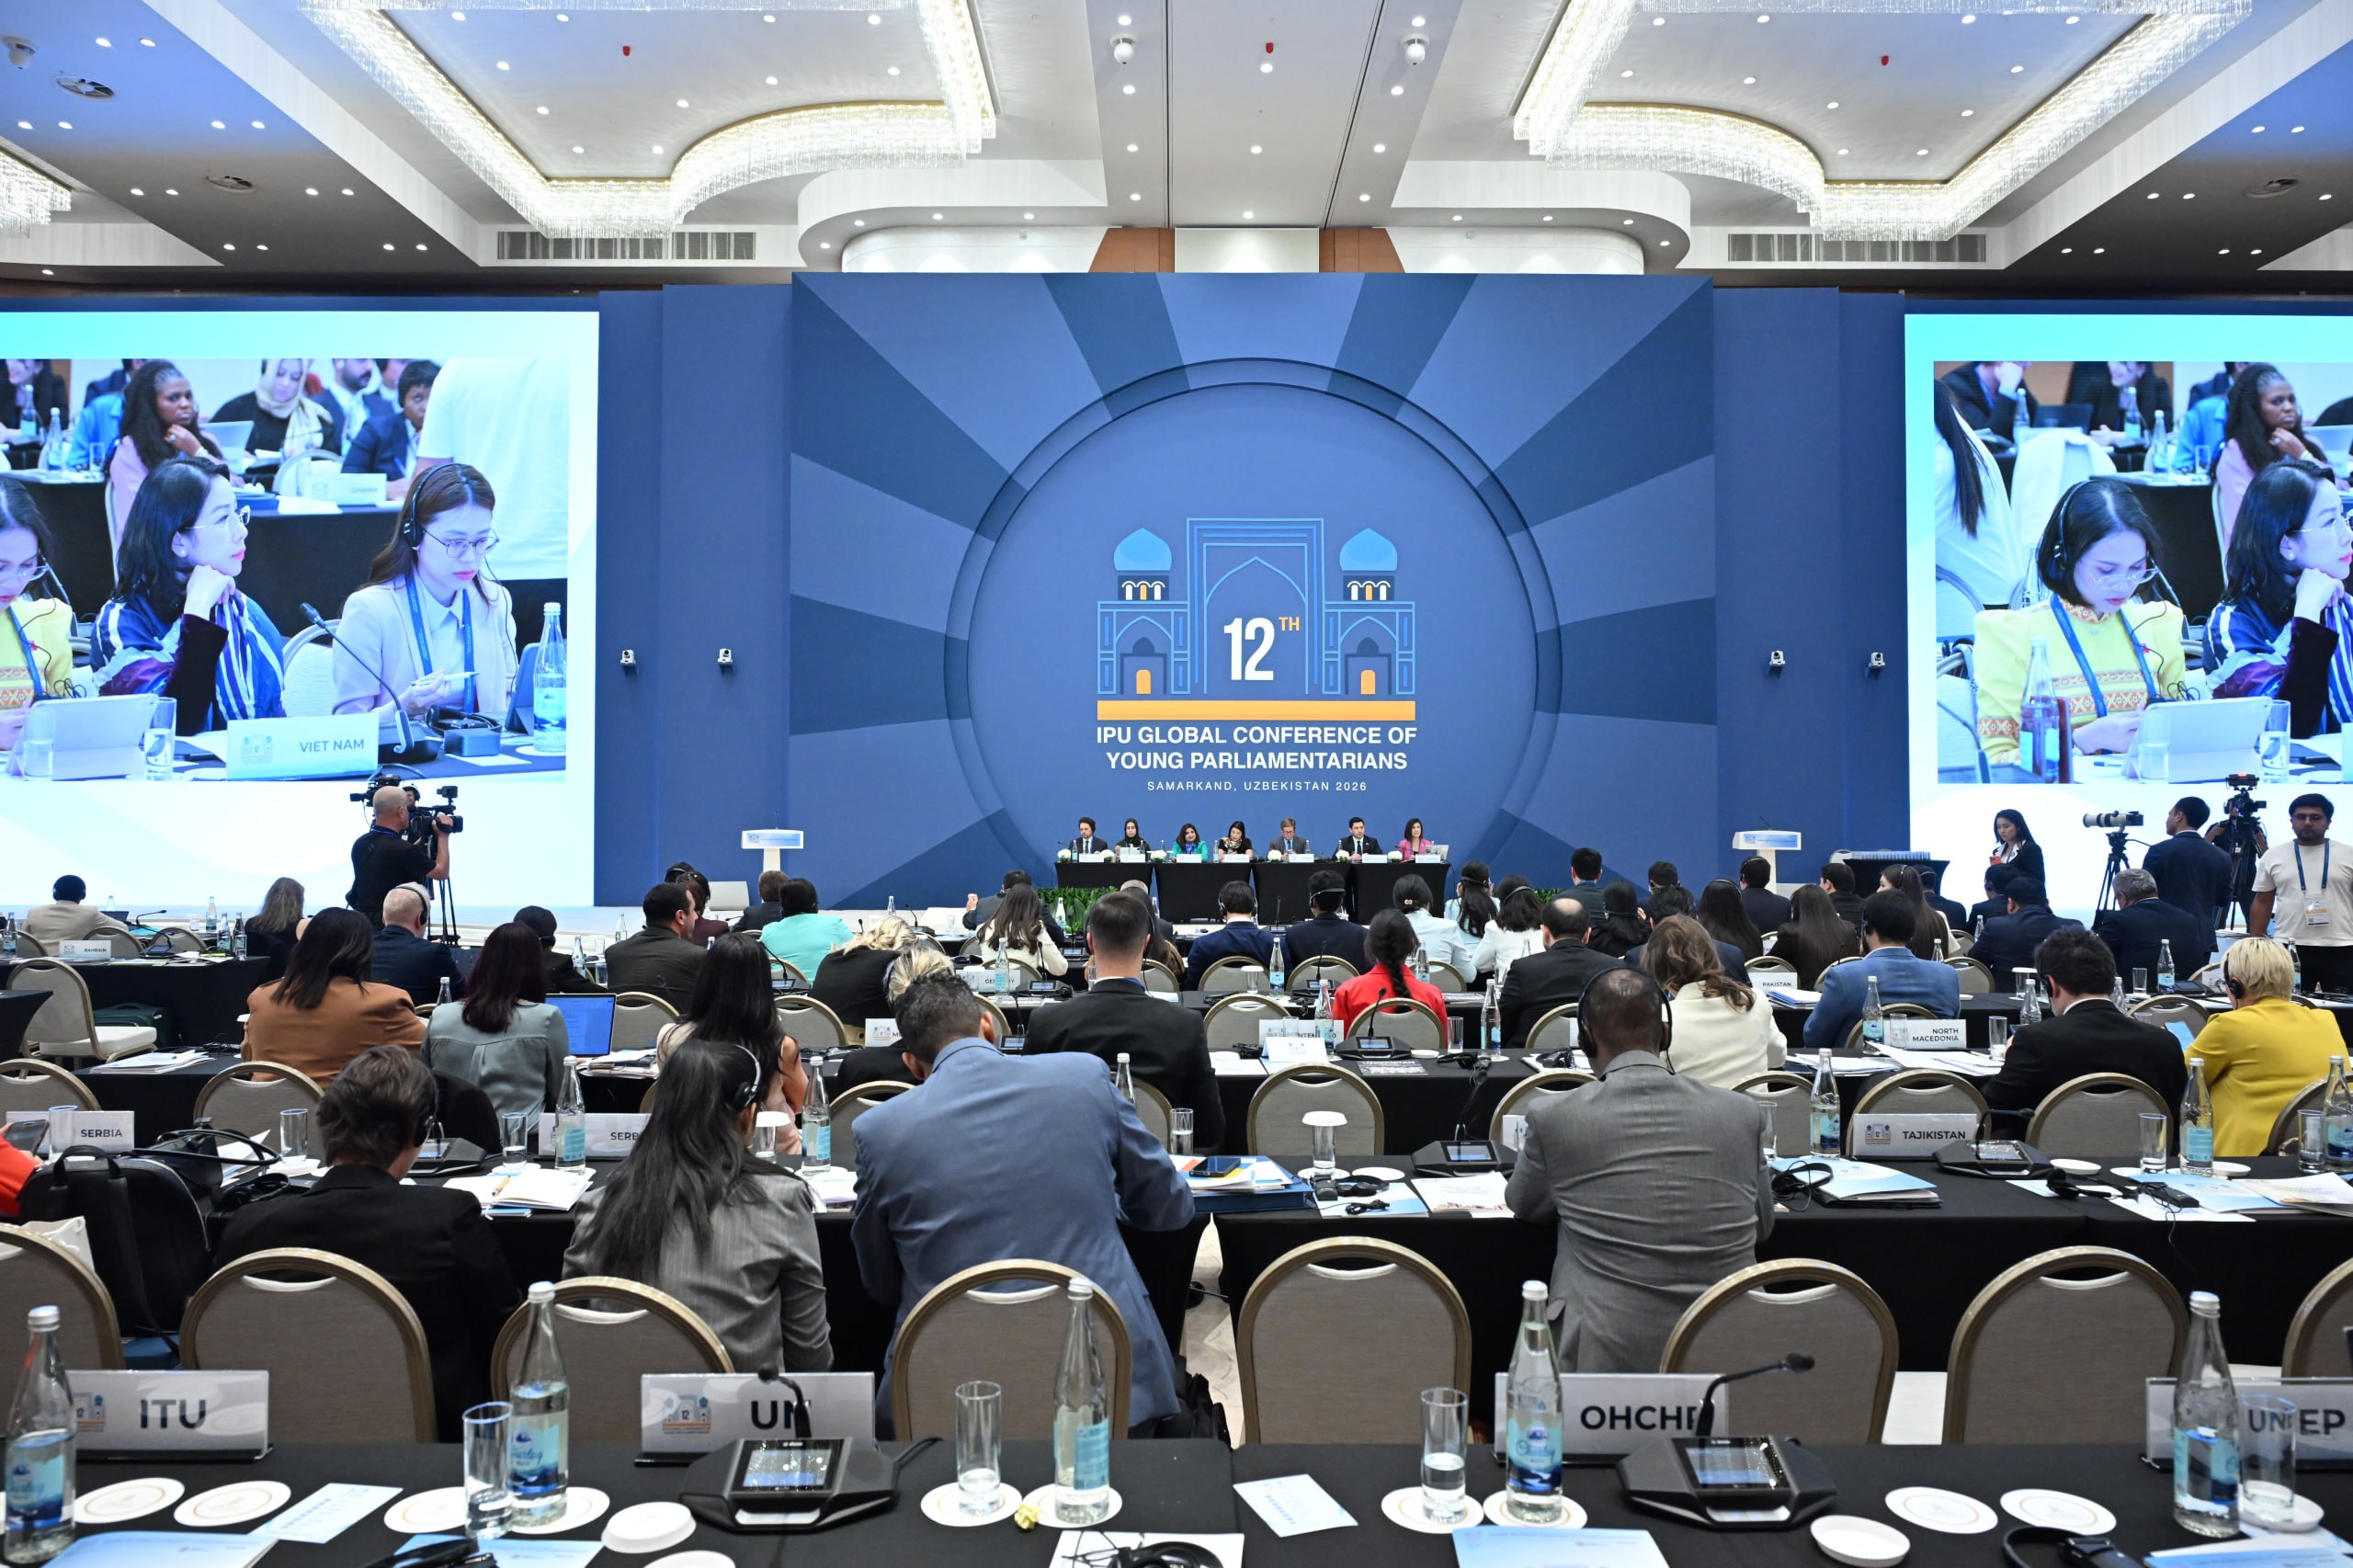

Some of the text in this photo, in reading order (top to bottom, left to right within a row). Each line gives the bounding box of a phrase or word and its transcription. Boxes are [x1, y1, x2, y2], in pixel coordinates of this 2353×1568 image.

[1097, 726, 1417, 744] IPU GLOBAL CONFERENCE OF
[300, 738, 364, 753] VIET NAM
[1107, 751, 1407, 770] YOUNG PARLIAMENTARIANS
[1147, 780, 1367, 792] SAMARKAND, UZBEKISTAN 2026
[80, 1129, 123, 1138] SERBIA
[610, 1131, 641, 1141] SERB
[1902, 1131, 1966, 1140] TAJIKISTAN
[140, 1399, 207, 1430] ITU
